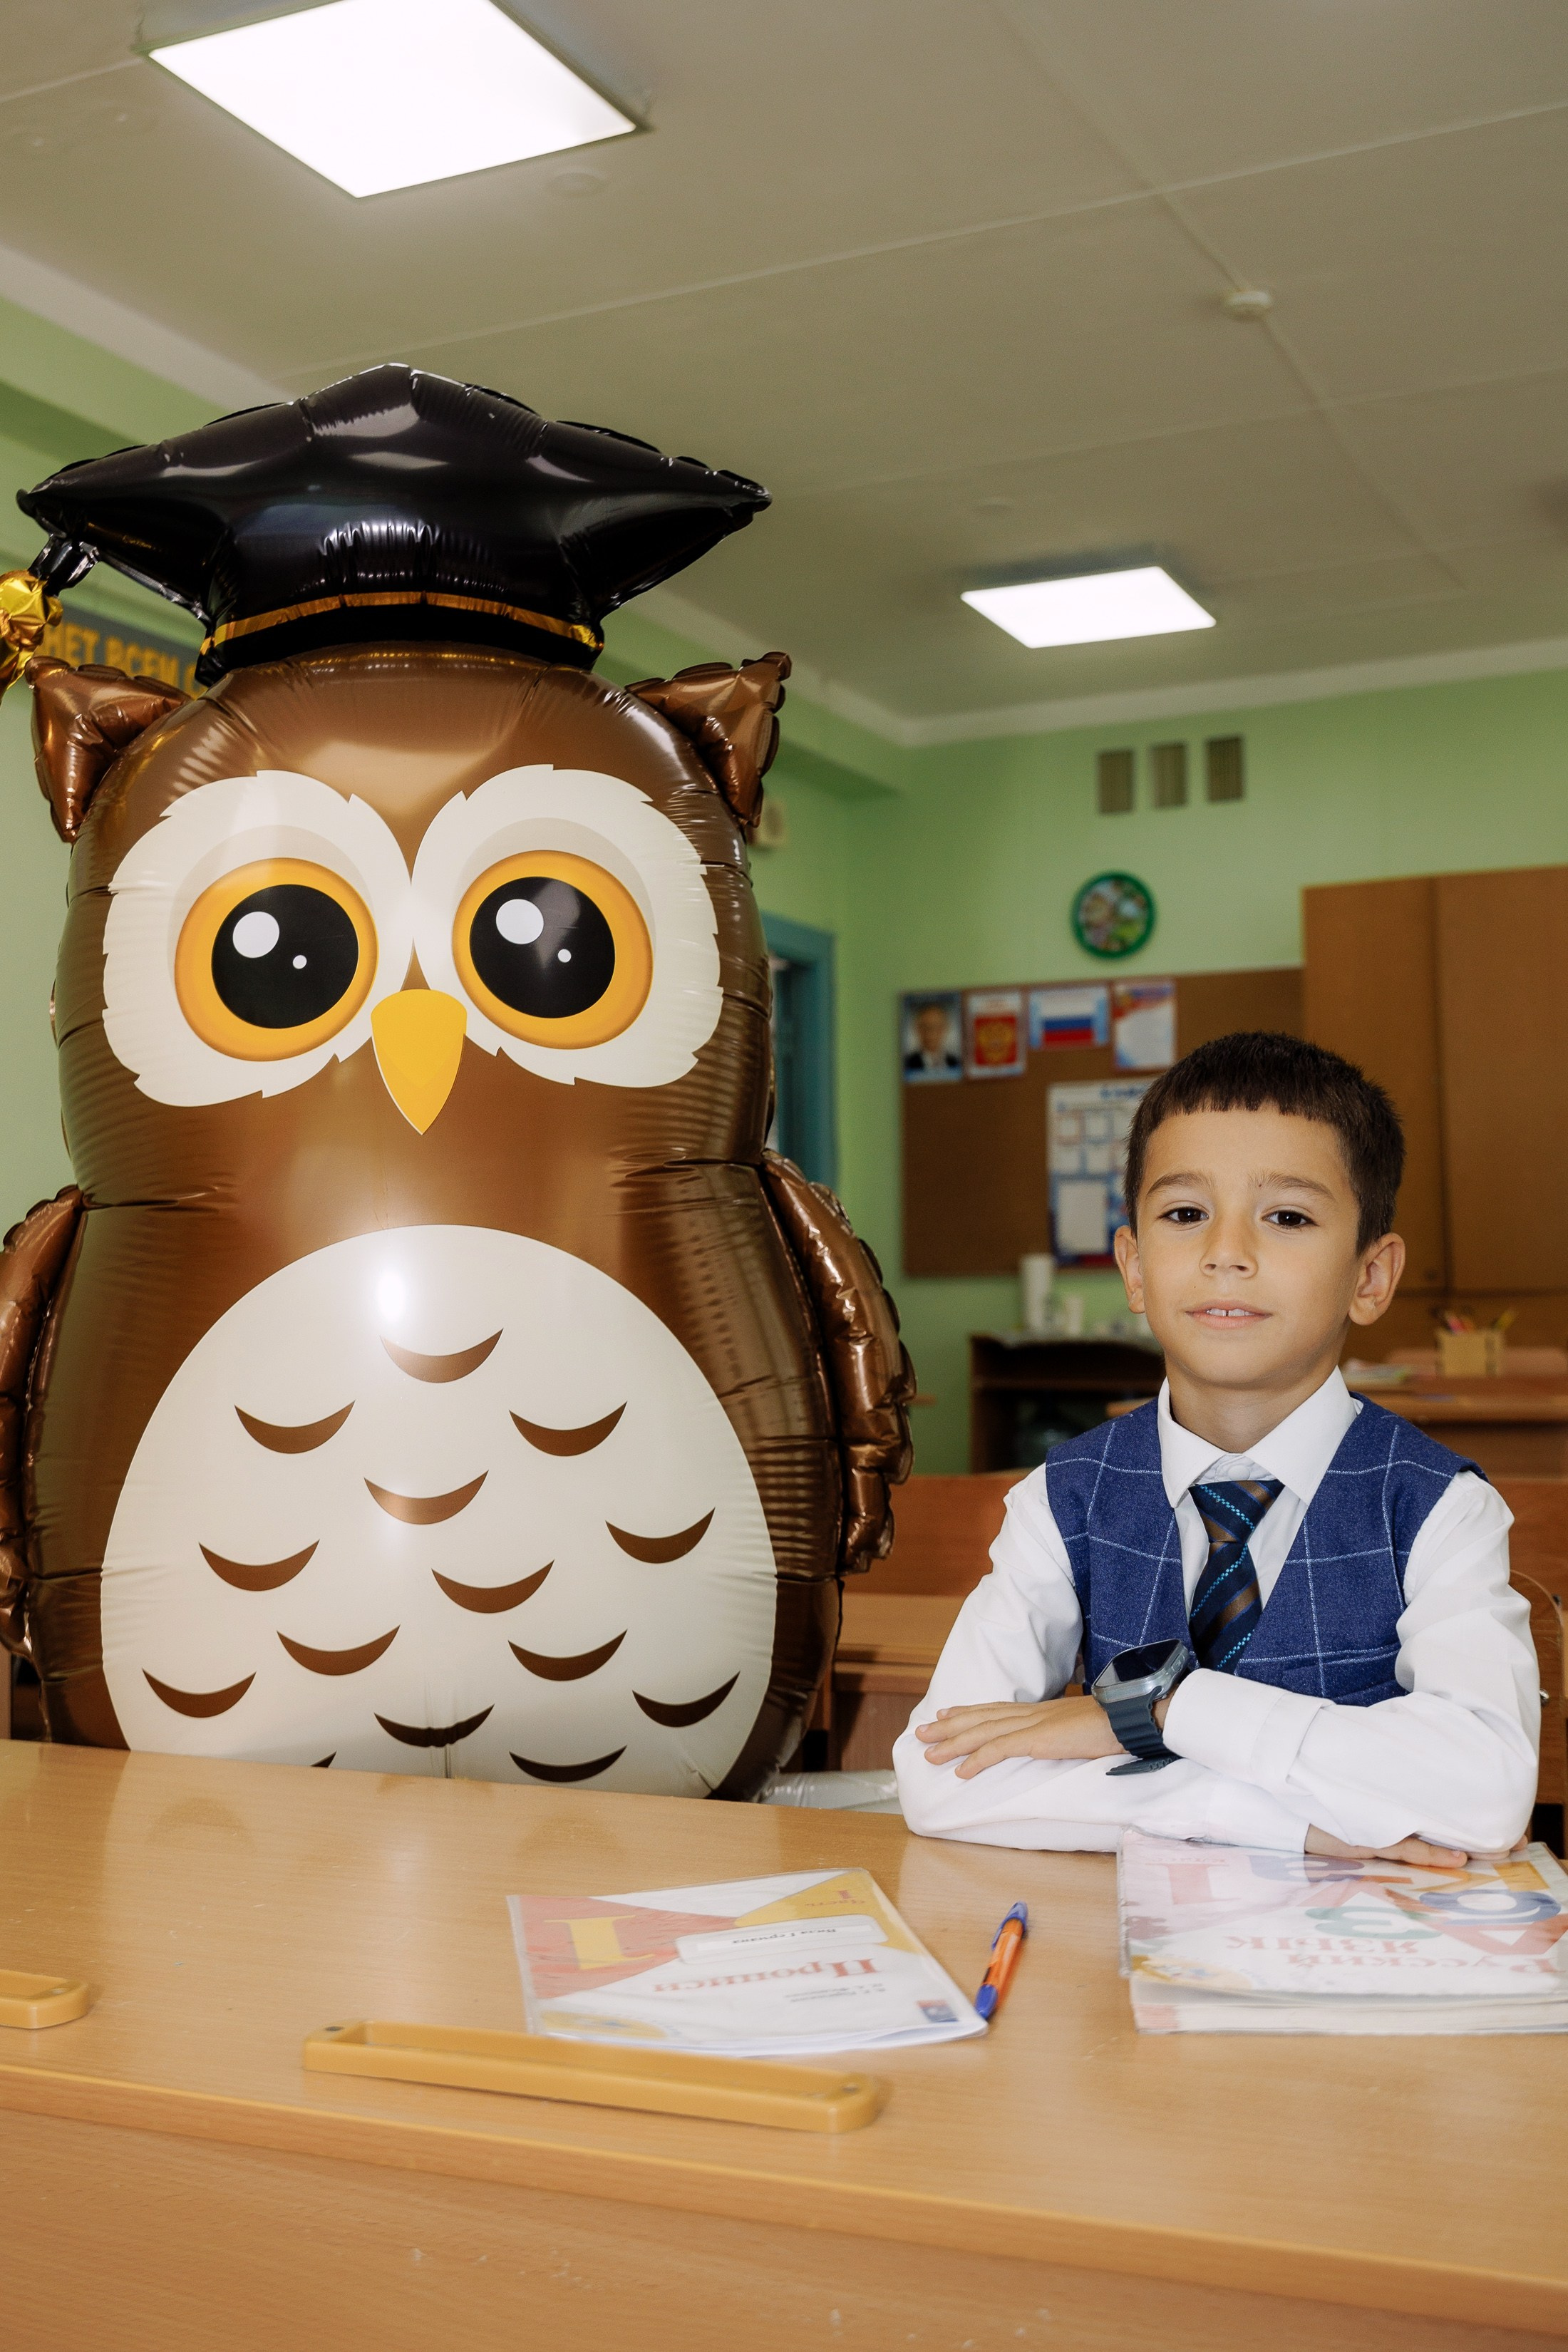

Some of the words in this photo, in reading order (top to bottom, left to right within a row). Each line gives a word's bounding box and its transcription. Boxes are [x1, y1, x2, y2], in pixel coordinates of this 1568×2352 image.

[1145, 1862, 1242, 1906] 1
[543, 1915, 656, 1971] 1
[732, 1932, 795, 1944] Германа
[653, 1958, 882, 1992] Прописи
[1288, 1954, 1567, 1974] Русский
